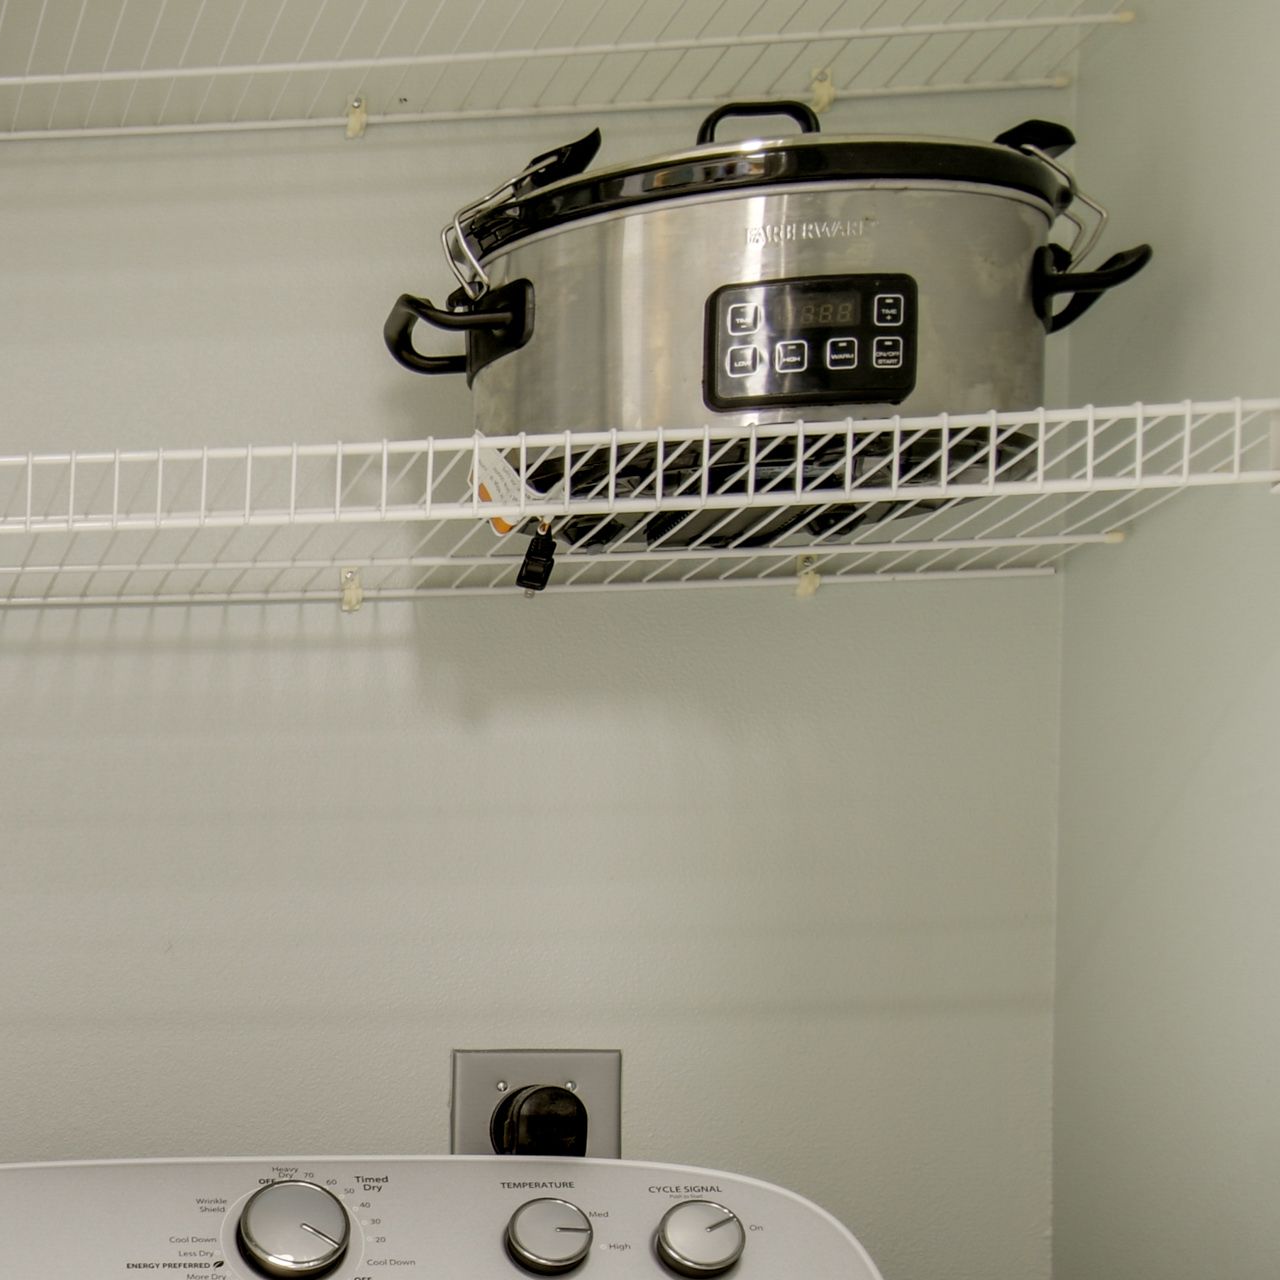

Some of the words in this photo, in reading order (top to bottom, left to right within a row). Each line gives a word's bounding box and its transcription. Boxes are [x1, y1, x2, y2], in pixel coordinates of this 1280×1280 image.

[354, 1175, 389, 1183] Timed
[363, 1184, 383, 1193] Dry
[500, 1181, 575, 1189] TEMPERATURE
[648, 1186, 681, 1194] CYCLE
[684, 1185, 723, 1193] SIGNAL
[749, 1224, 764, 1232] On
[168, 1236, 190, 1244] Cool
[191, 1236, 218, 1244] Down
[608, 1242, 632, 1250] High
[199, 1250, 215, 1258] Dry
[366, 1258, 388, 1266] Cool
[389, 1258, 416, 1266] Down
[211, 1273, 227, 1280] Dry
